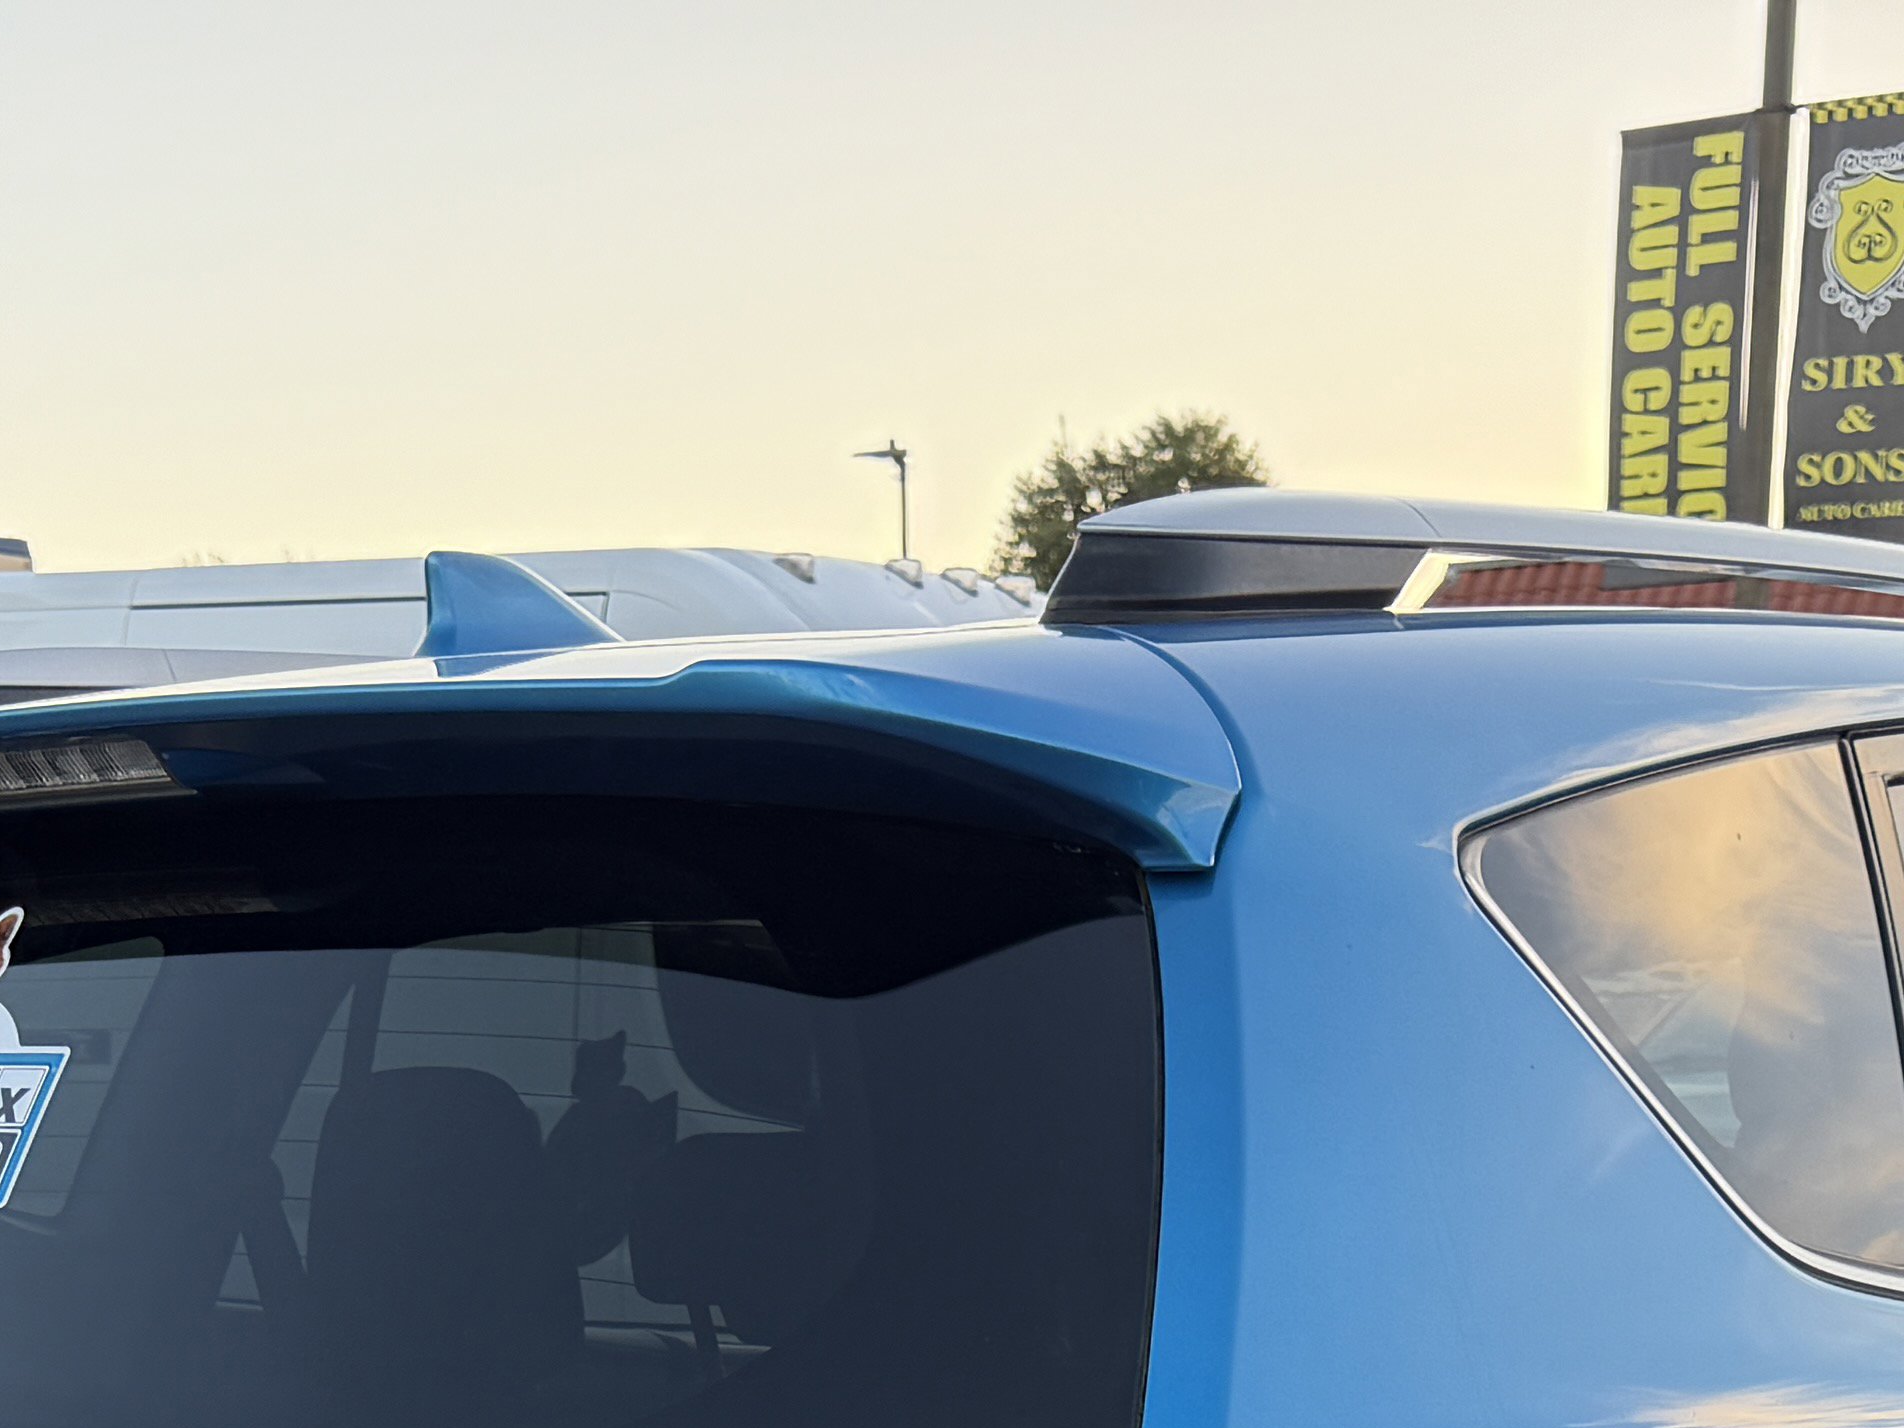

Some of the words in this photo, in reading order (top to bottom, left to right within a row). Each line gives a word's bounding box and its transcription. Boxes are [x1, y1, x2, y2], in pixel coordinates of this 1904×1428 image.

[1624, 185, 1681, 353] AUTO
[1685, 131, 1745, 277] FULL
[1676, 302, 1735, 523] SERVIC
[1835, 404, 1877, 434] &
